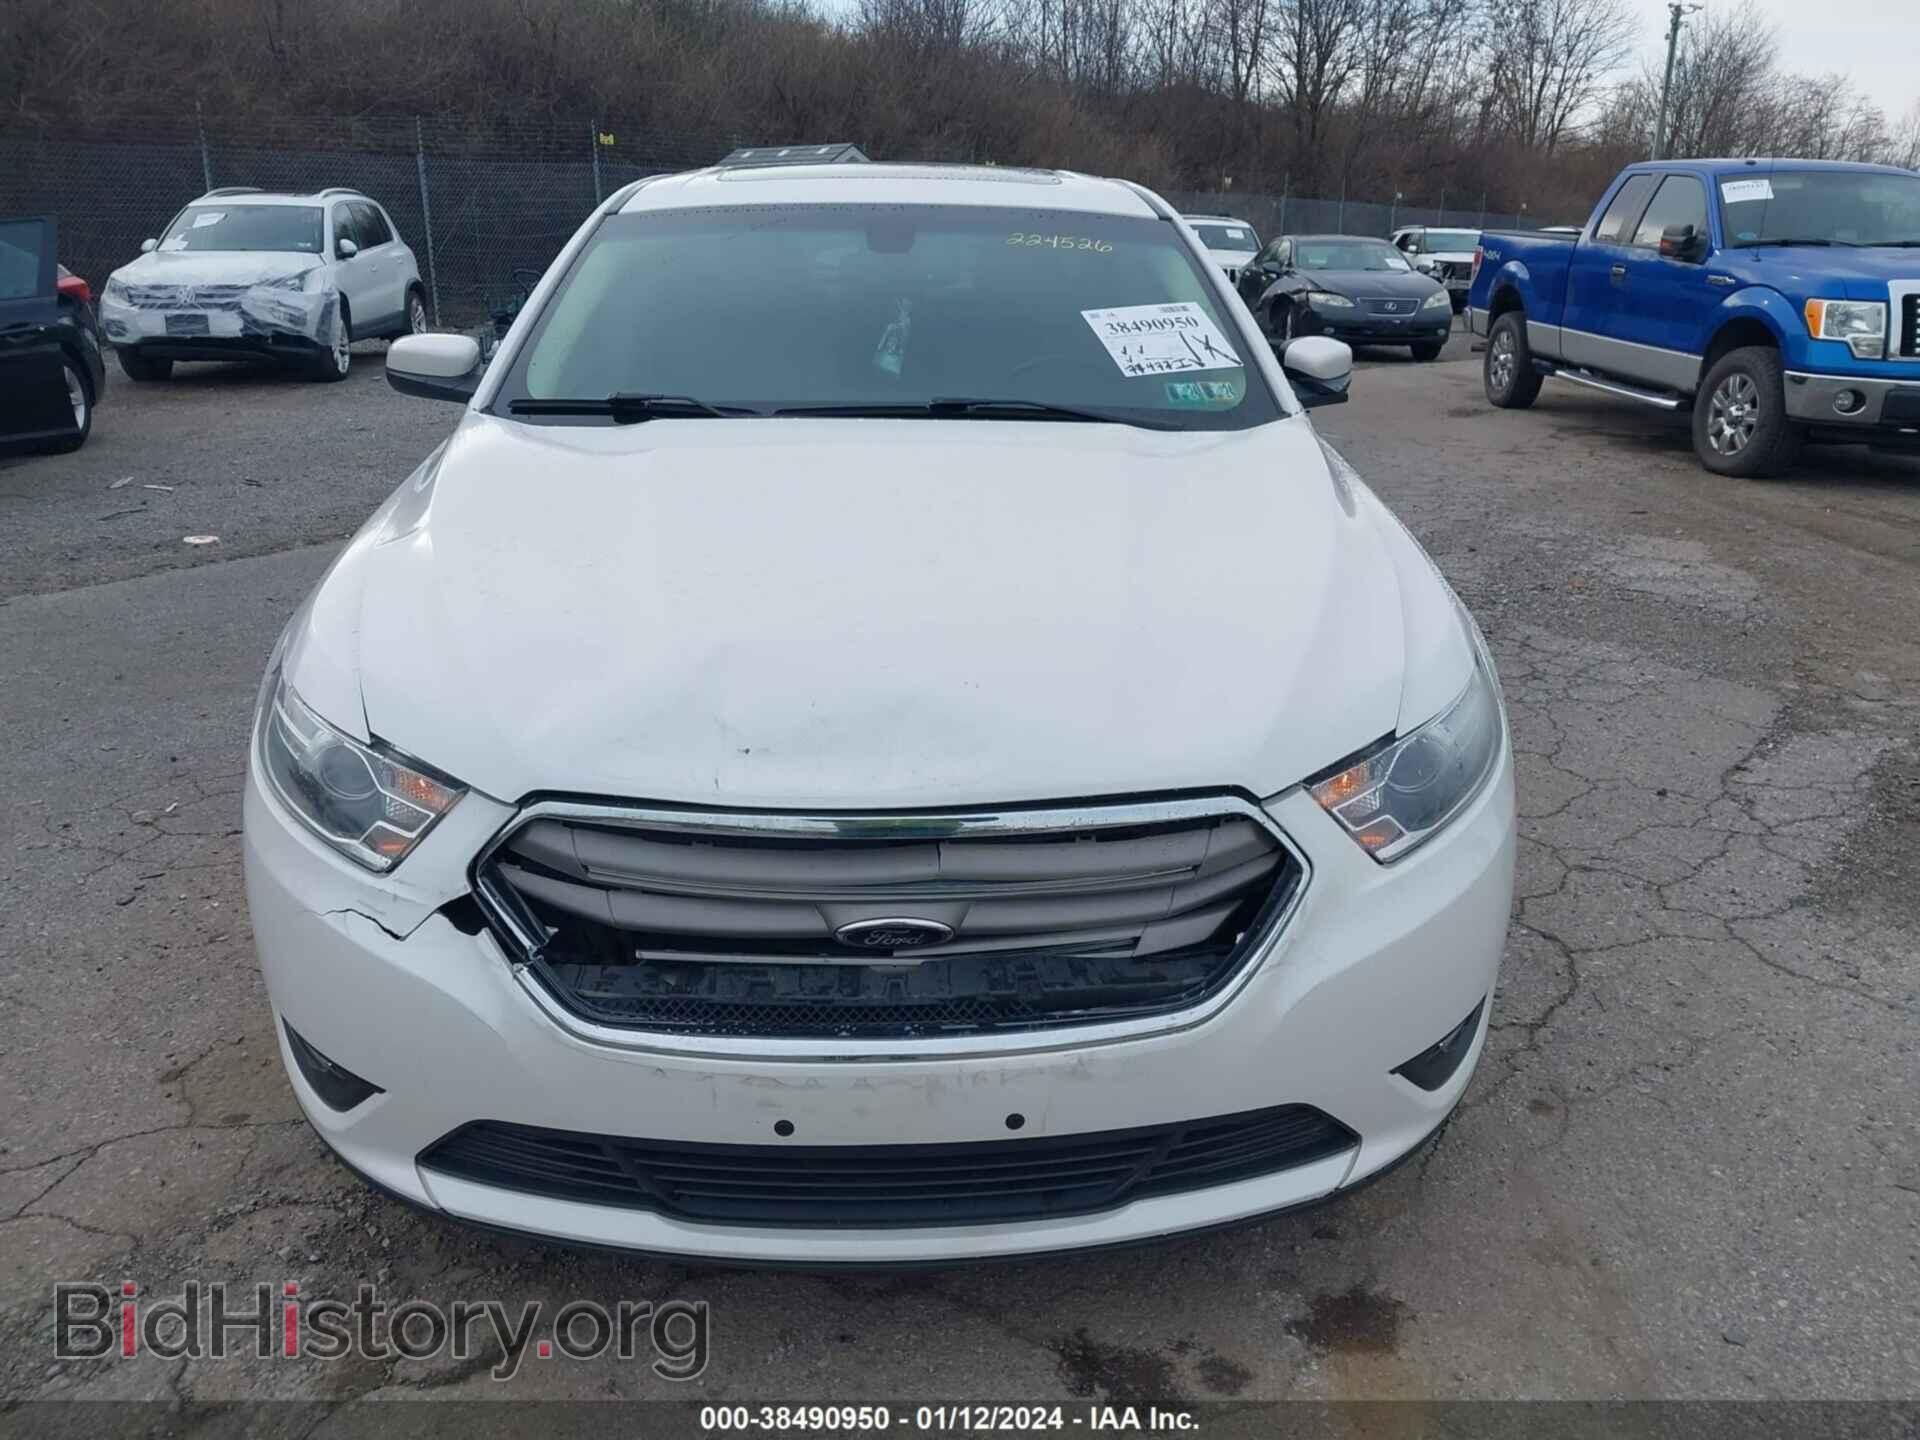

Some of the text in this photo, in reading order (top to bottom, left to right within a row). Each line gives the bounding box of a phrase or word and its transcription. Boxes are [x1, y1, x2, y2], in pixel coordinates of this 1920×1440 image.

[1007, 232, 1113, 252] 224526
[1104, 315, 1200, 336] 38490950
[863, 928, 926, 946] Ford
